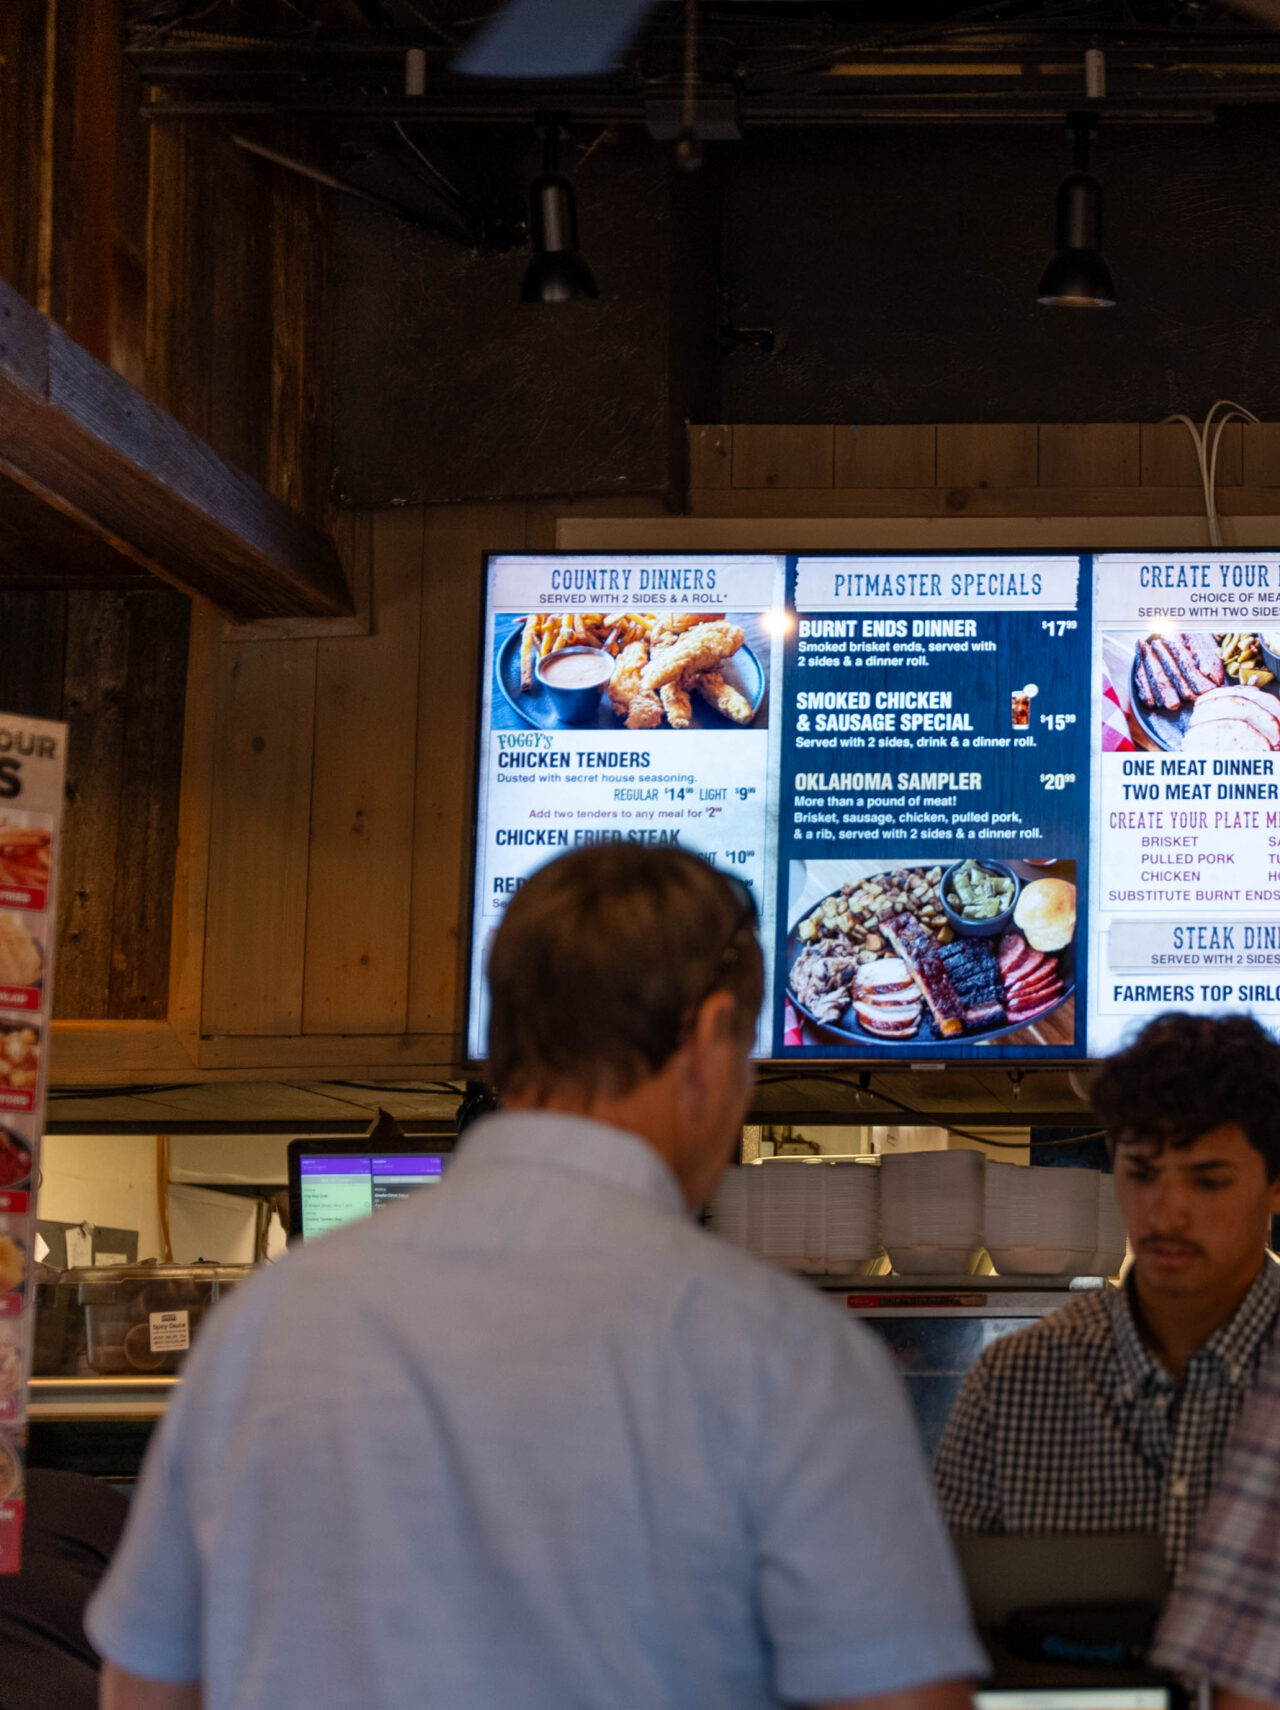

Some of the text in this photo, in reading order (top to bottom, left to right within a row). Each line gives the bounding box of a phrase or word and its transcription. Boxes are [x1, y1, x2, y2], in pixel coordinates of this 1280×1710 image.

[552, 569, 716, 590] COUNTRY DINNERS
[1140, 565, 1211, 588] CREATE
[1219, 564, 1270, 588] YOUR
[834, 573, 1042, 597] PITMASTER SPECIALS
[1190, 592, 1235, 603] CHOICE
[1238, 592, 1254, 603] OF
[798, 619, 977, 638] BURNT ENDS DINNER
[798, 640, 997, 653] Smoked brisket ends, served with
[797, 655, 929, 667] 2 sides & a dinner roll.
[796, 691, 952, 710] SMOKED CHICKEN
[796, 713, 974, 732] & SAUSAGE SPECIAL
[795, 736, 1037, 748] Served with 2 sides, drink & a dinner roll.
[498, 752, 650, 768] CHICKEN TENDERS
[1122, 759, 1274, 776] ONE MEAT DINNER
[496, 772, 697, 785] Dusted with secret house seasoning.
[795, 772, 982, 791] OKLAHOMA SAMPLER
[614, 788, 728, 801] REGULAR LIGHT
[1122, 784, 1278, 800] TWO MEAT DINNER
[794, 795, 957, 809] More than a pound of meat!
[528, 808, 703, 821] Add two tenders to any meal for
[794, 811, 1022, 826] Brisket, sausage, chicken, pulled pork,
[1110, 811, 1163, 829] CREATE
[1170, 811, 1208, 829] YOUR
[1215, 811, 1259, 829] PLATE
[496, 830, 568, 846] CHICKEN
[1142, 836, 1199, 847] BRISKET
[1141, 853, 1235, 864] PULLED PORK
[1141, 871, 1200, 882] CHICKEN
[1174, 926, 1235, 950] STEAK
[1114, 985, 1194, 1002] FARMERS
[1200, 985, 1233, 1002] TOP
